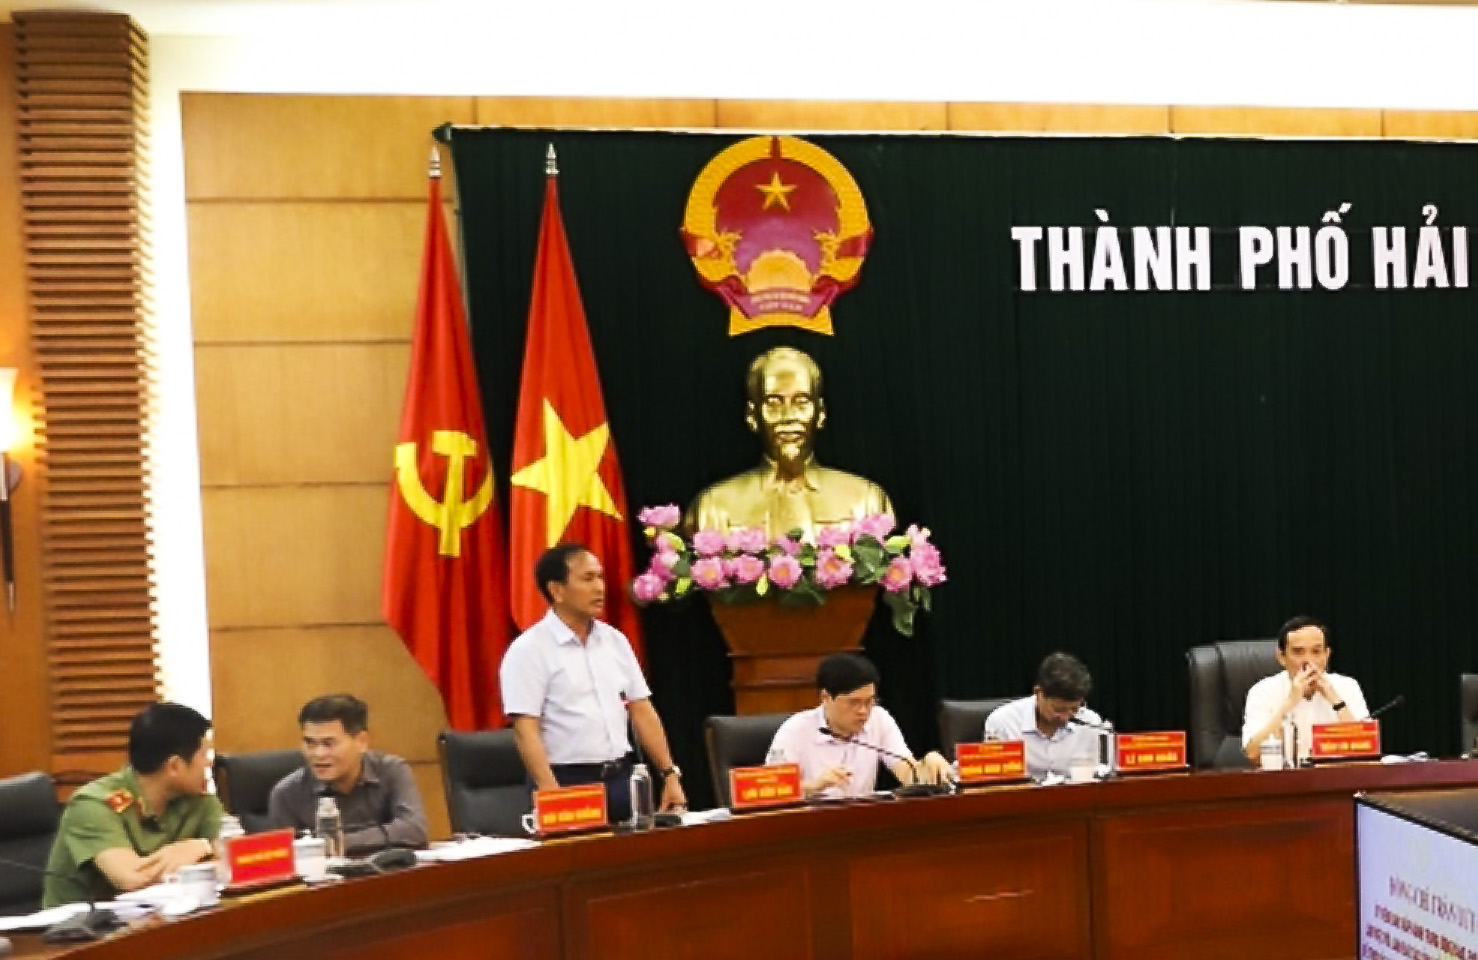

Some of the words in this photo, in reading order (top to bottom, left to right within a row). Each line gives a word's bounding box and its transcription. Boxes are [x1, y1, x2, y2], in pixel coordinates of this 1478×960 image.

[1011, 209, 1212, 292] THÀNH
[1239, 203, 1352, 291] PHỐ
[1373, 204, 1468, 289] HẢI
